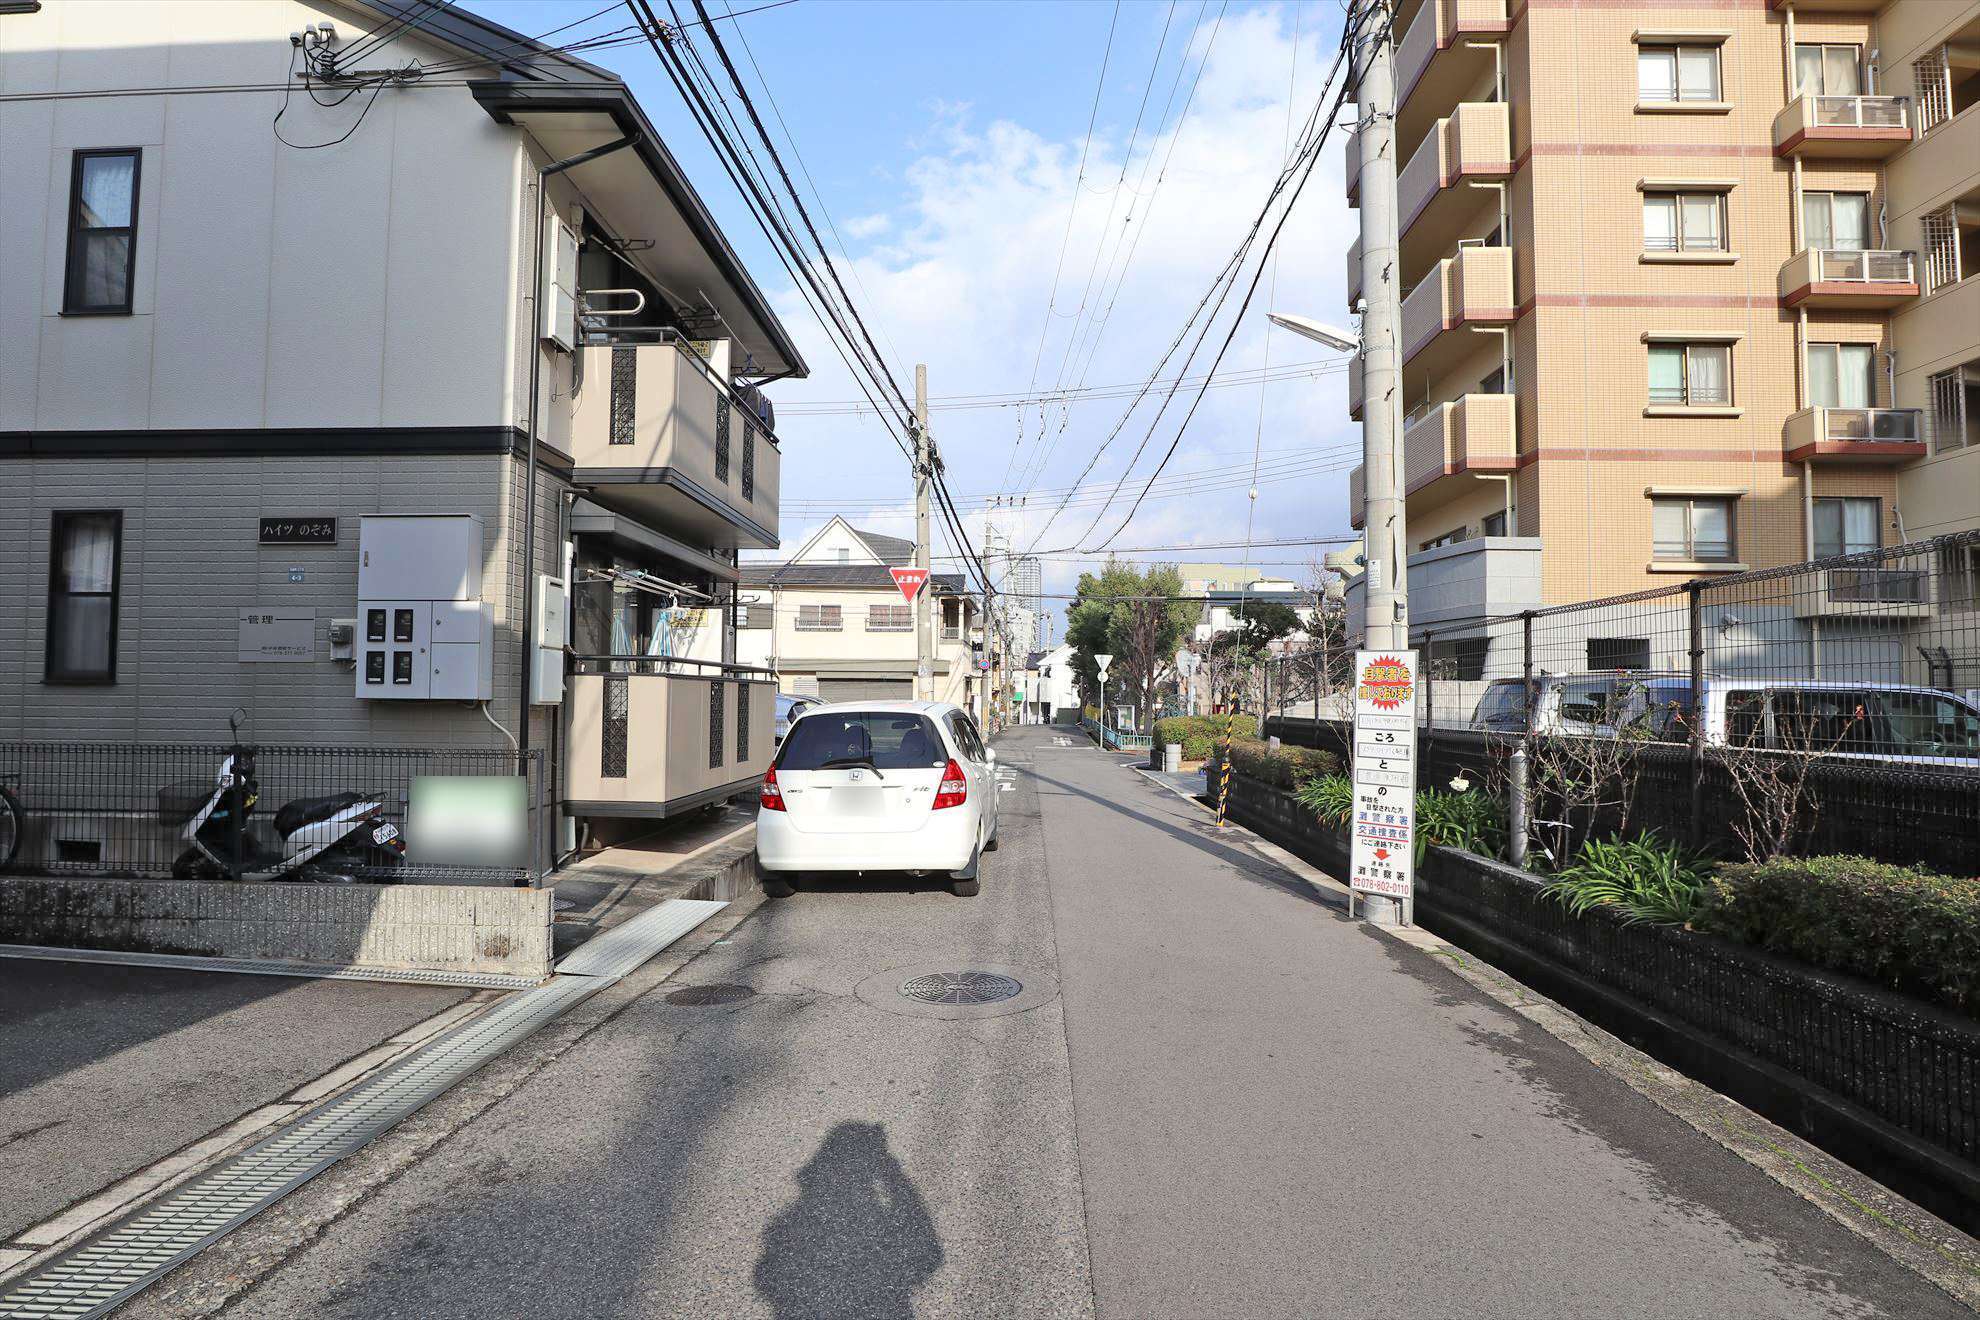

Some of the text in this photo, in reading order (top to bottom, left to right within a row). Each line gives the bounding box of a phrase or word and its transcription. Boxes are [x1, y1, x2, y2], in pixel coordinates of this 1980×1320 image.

[263, 524, 332, 536] ハイツ のぞみ
[897, 575, 922, 584] 止まれ
[1364, 666, 1411, 681] 目撃者を
[1375, 732, 1395, 743] ころ
[1379, 759, 1388, 770] と
[1377, 786, 1388, 796] の
[1360, 795, 1379, 804] 事故を
[1366, 803, 1405, 815] 目撃された方
[1361, 878, 1410, 895] 078-802-0110
